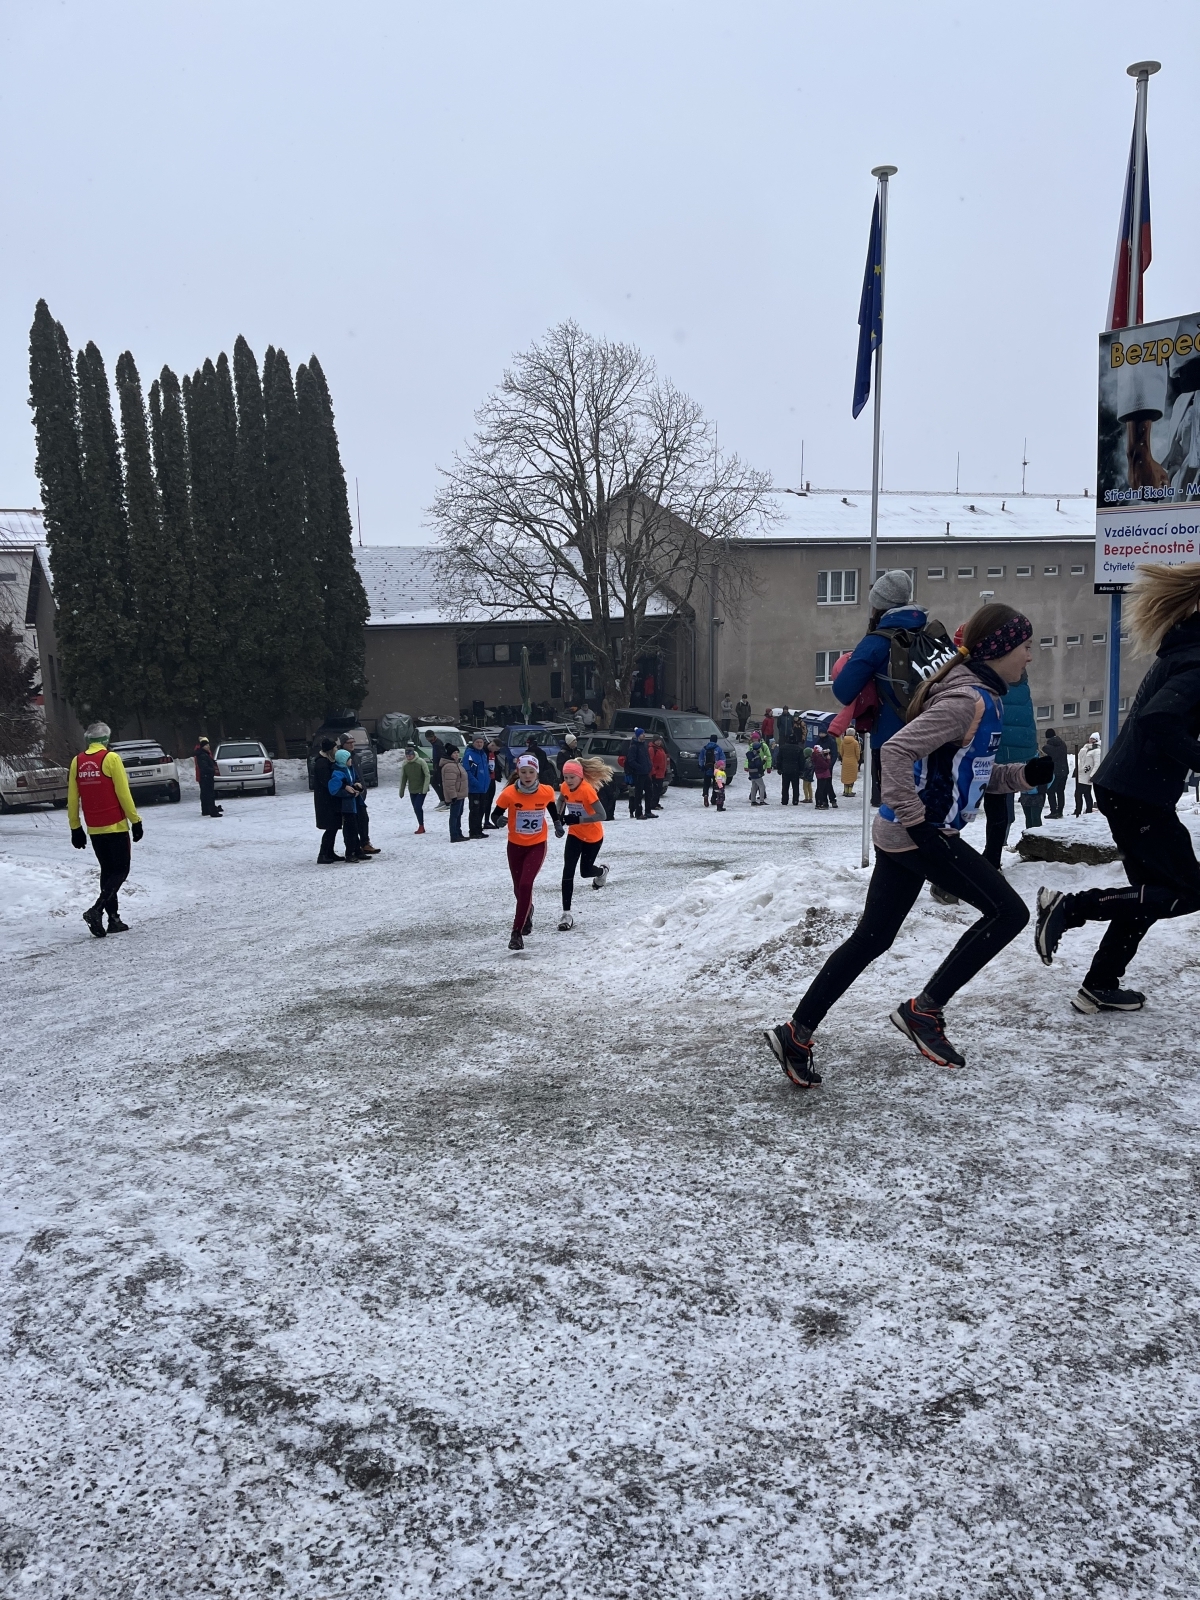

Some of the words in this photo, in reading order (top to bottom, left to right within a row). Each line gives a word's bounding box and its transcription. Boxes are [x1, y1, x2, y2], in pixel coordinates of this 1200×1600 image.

[1104, 486, 1143, 502] Střední
[1144, 485, 1175, 499] škola
[1104, 523, 1168, 538] Vzdělávací
[1104, 540, 1195, 558] Bezpečnostně
[521, 819, 539, 830] 26
